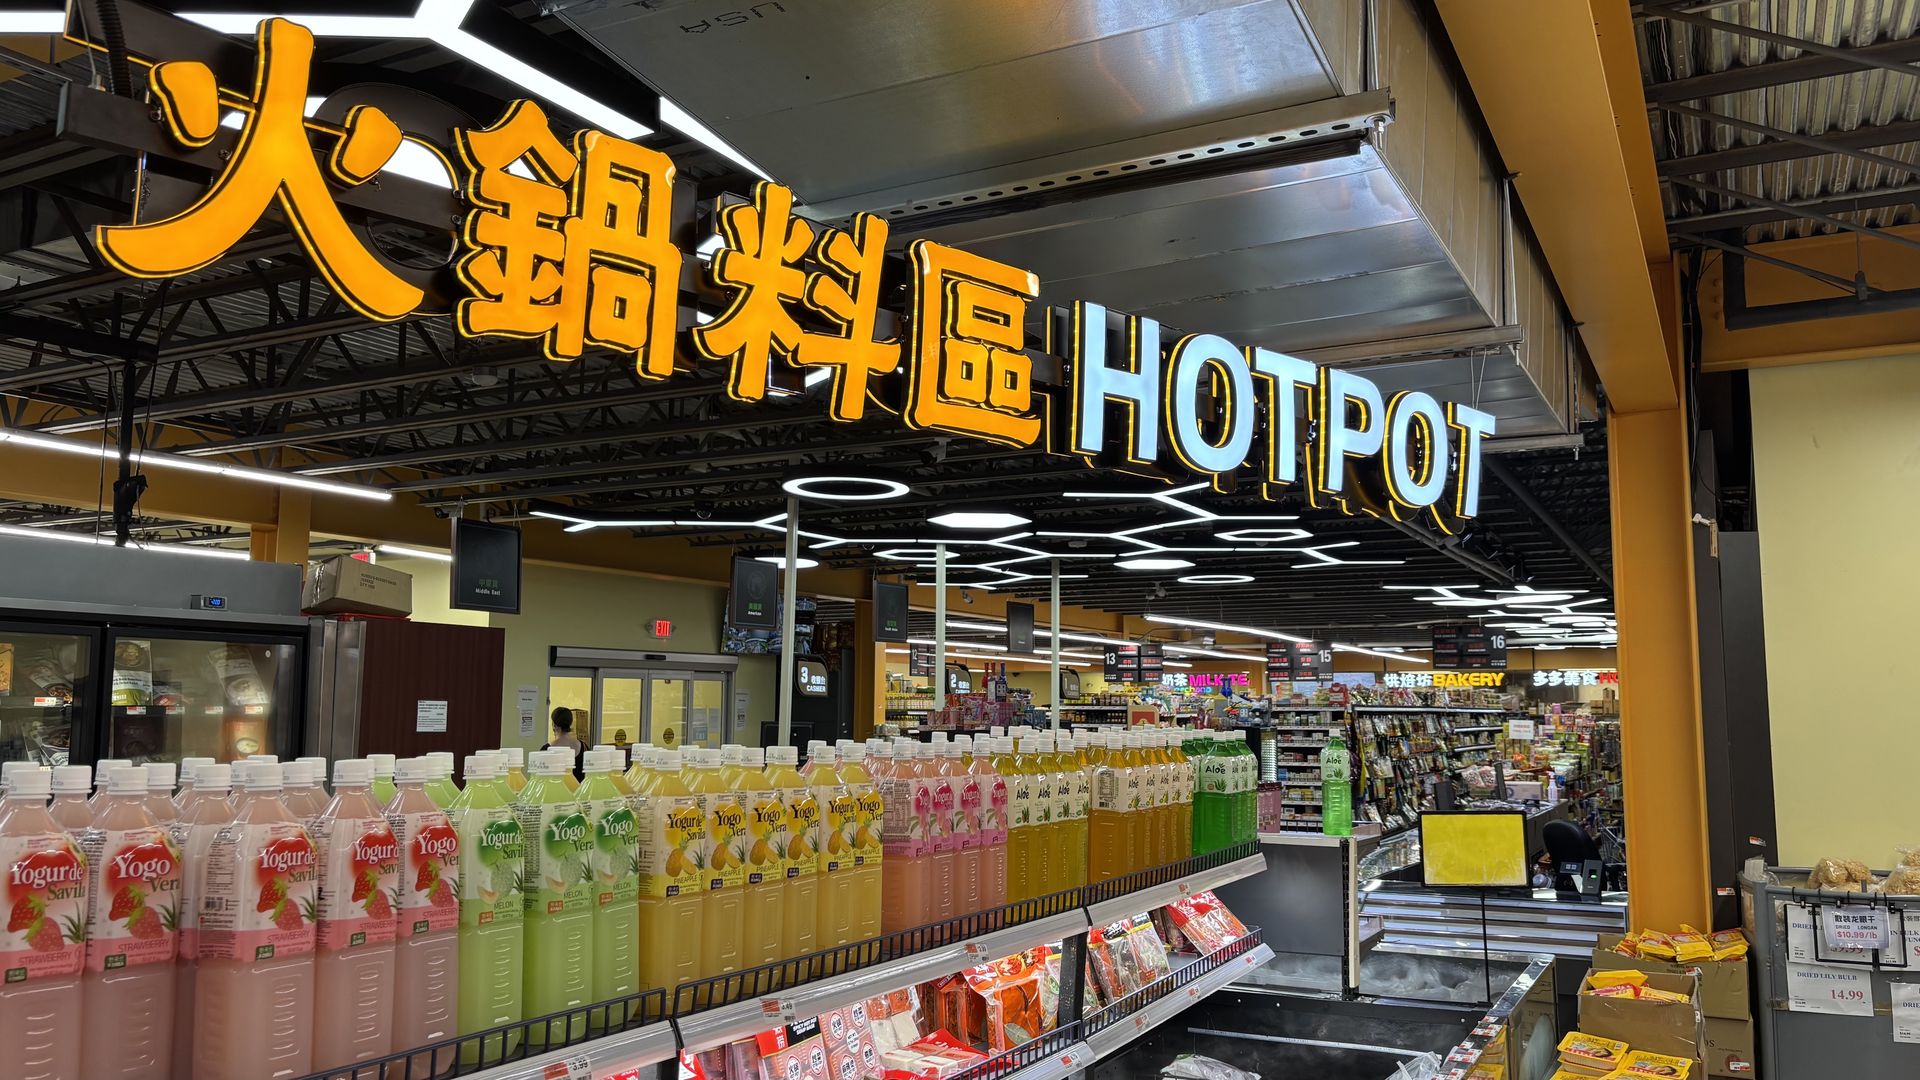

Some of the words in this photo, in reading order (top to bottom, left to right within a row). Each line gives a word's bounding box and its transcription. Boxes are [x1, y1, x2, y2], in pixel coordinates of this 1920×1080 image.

[95, 17, 1041, 449] 火鍋料區
[1074, 300, 1496, 519] HOTPOT
[655, 620, 671, 637] EXIT
[1491, 635, 1505, 649] 16
[911, 648, 918, 661] 12
[1105, 652, 1116, 665] 13
[1319, 649, 1332, 663] 15
[800, 666, 809, 684] 3
[950, 673, 957, 688] 2
[1161, 673, 1188, 687] 奶茶
[1228, 673, 1250, 686] TE
[1432, 673, 1505, 687] BAKERY
[1533, 670, 1599, 687] 多多美食
[1326, 756, 1342, 765] Aloe
[1205, 763, 1226, 775] Aloe
[1016, 786, 1030, 800] Aloe
[1038, 786, 1051, 799] Aloe
[1058, 783, 1070, 796] Aloe
[790, 803, 815, 821] Yogo
[856, 797, 880, 815] Yogo
[667, 813, 696, 832] Yogur
[713, 810, 741, 830] Yogo
[753, 806, 781, 826] Yogo
[549, 821, 586, 845] Yogo
[600, 817, 633, 839] Yogo
[770, 823, 787, 834] Vera
[416, 834, 457, 857] Yogo
[479, 827, 515, 850] Yogur
[257, 847, 301, 872] Yogur
[303, 849, 316, 864] de
[353, 841, 393, 864] Yogur
[9, 860, 70, 889] Yogur
[69, 863, 84, 881] de
[112, 853, 171, 882] Yogo
[613, 882, 631, 891] MELON
[563, 890, 583, 899] MELON
[494, 901, 514, 910] MELON
[1836, 931, 1878, 939] $10.99/lb
[118, 938, 169, 953] STRAWBERRY
[18, 951, 73, 966] STRAWBERRY
[1797, 971, 1819, 979] DRIED
[1830, 989, 1864, 1000] 14.99
